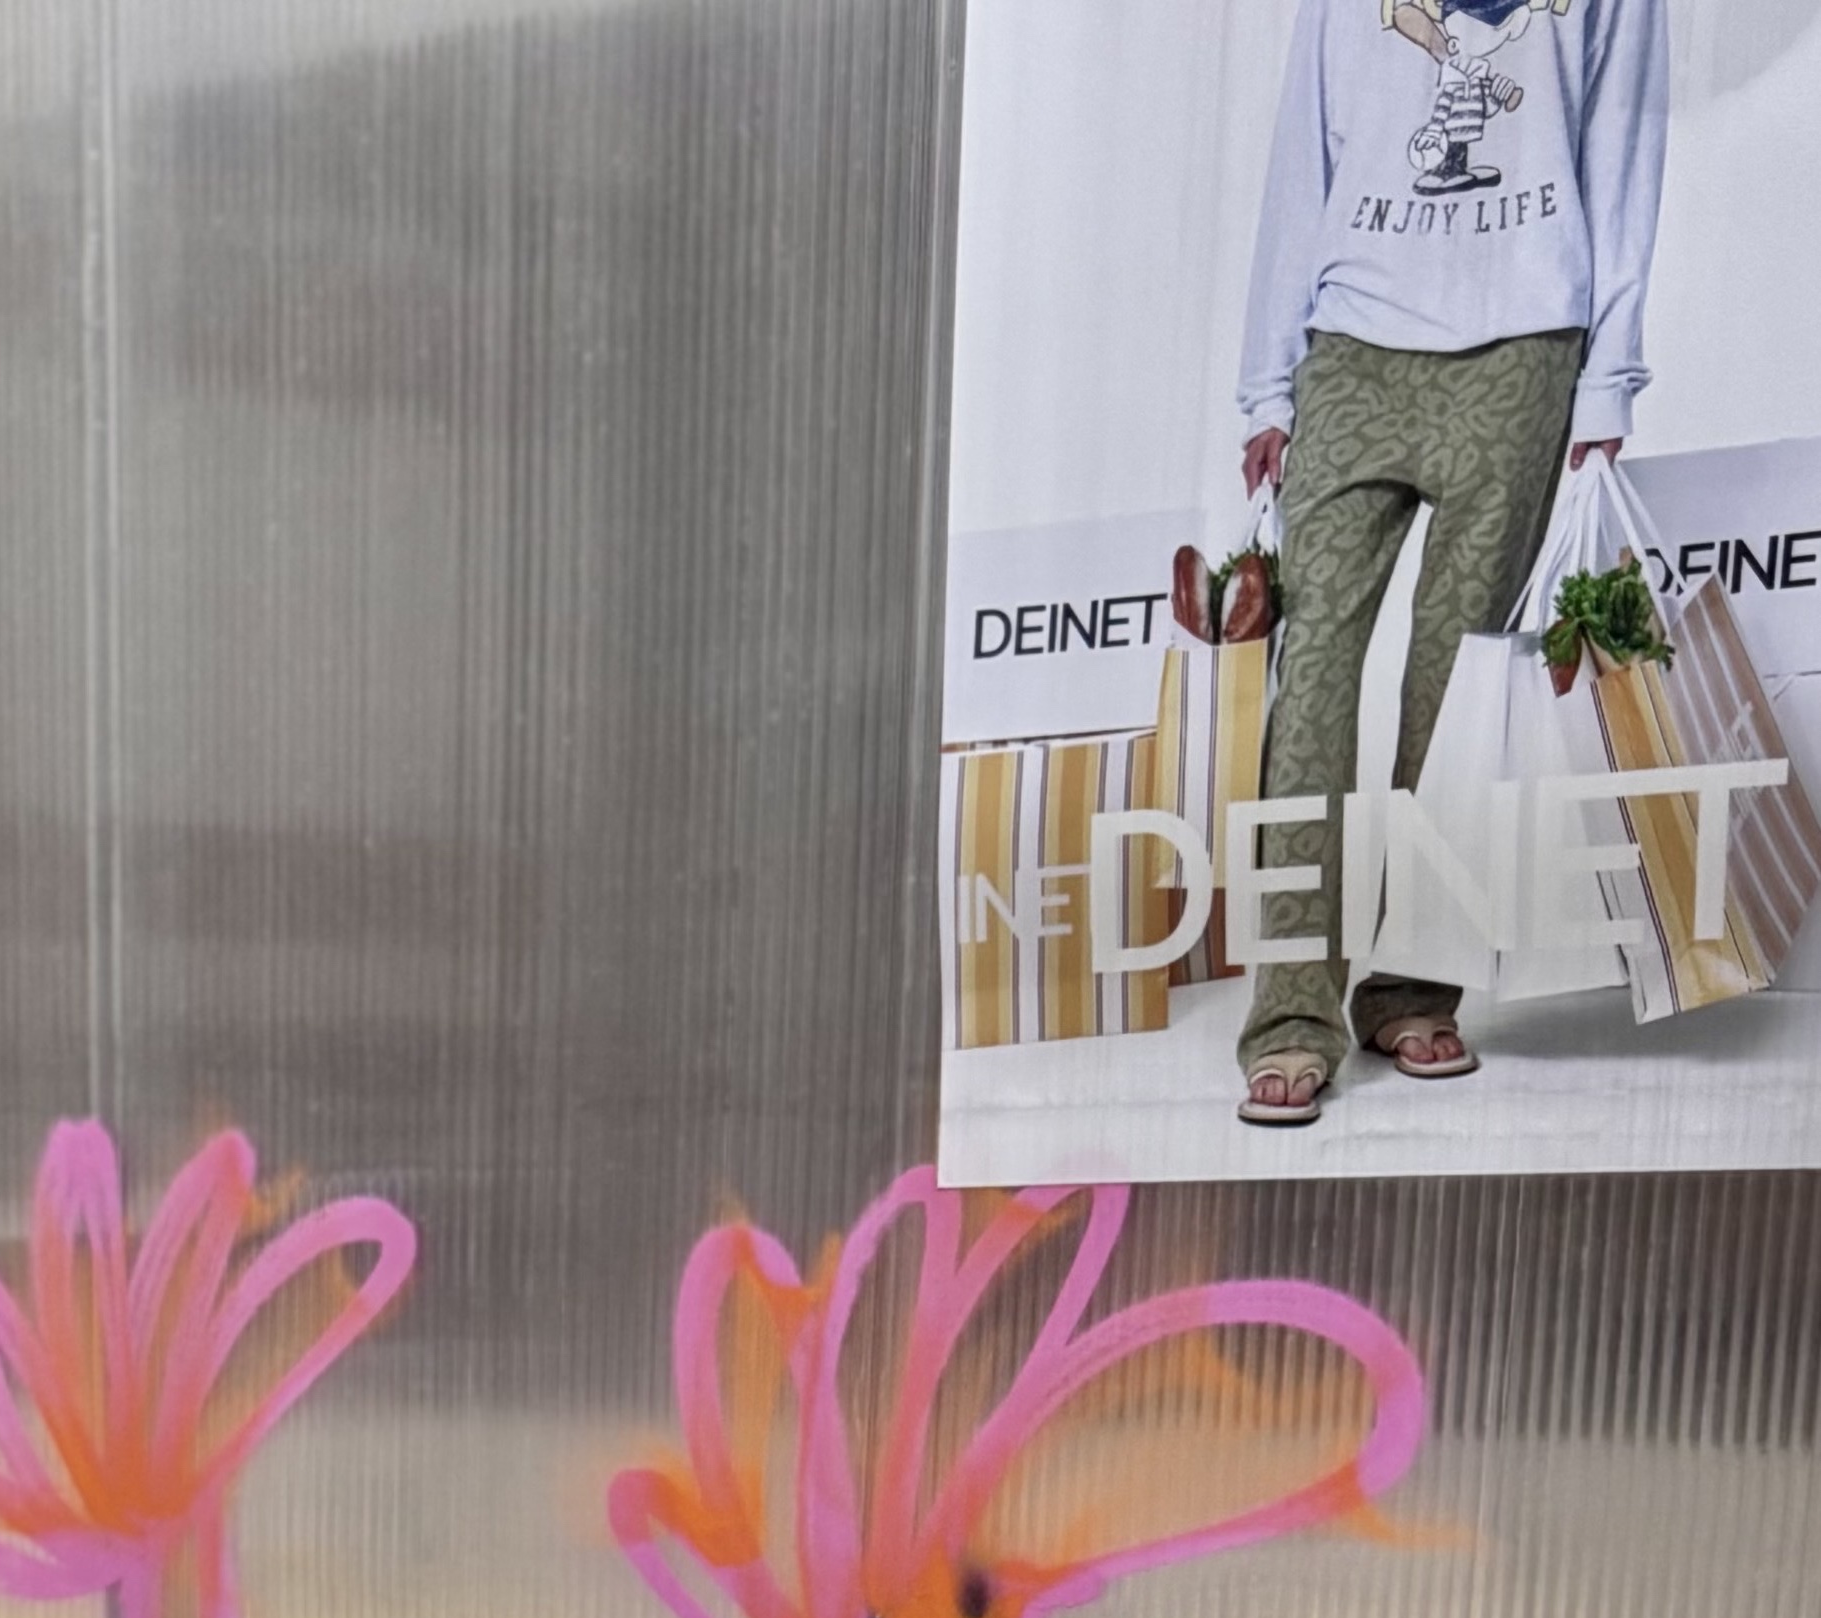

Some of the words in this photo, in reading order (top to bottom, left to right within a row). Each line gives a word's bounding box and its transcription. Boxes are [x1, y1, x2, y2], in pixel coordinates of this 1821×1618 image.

[1351, 196, 1460, 236] ENJOY
[1473, 182, 1558, 235] LIFE
[973, 592, 1169, 660] DEINET
[1090, 757, 1790, 973] DEINET
